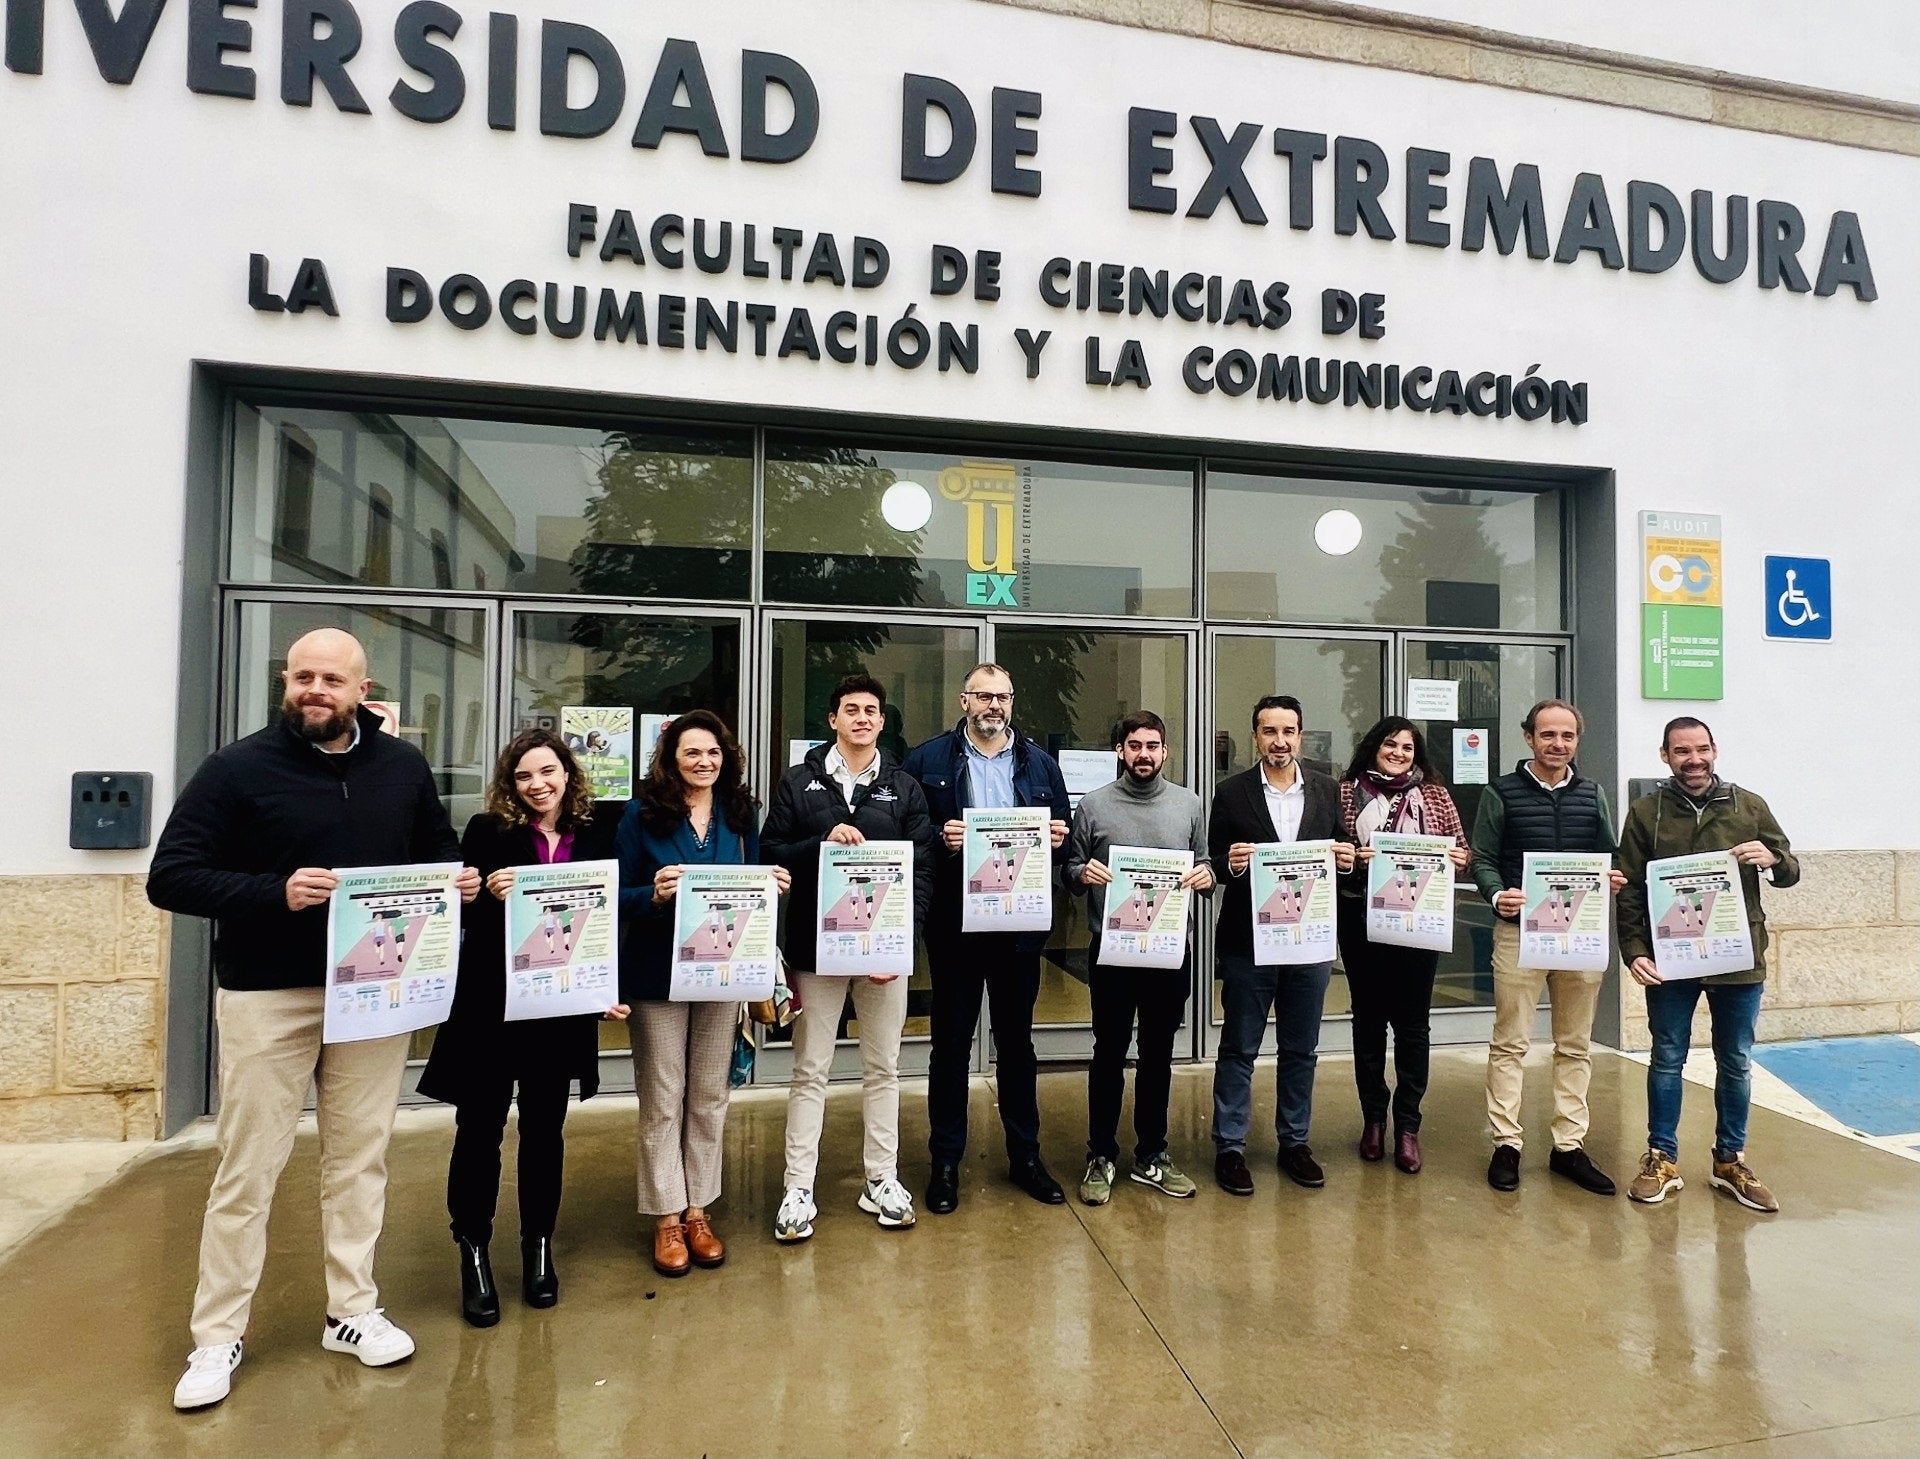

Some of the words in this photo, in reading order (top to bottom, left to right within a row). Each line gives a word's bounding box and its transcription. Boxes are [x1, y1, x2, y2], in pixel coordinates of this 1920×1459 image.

[5, 0, 819, 164] IVERSIDAD
[901, 73, 1041, 198] DE
[1128, 107, 1877, 302] EXTREMADURA
[568, 203, 890, 289] FACULTAD
[930, 245, 1001, 302] DE
[1039, 258, 1291, 330] CIENCIAS
[1322, 289, 1385, 340] DE
[249, 253, 339, 317] LA
[386, 267, 978, 374] DOCUMENTACIÓN
[1014, 329, 1051, 379] Y
[1086, 336, 1151, 389] LA
[1183, 346, 1587, 425] COMUNICACIÓN
[1022, 466, 1032, 528] EXTREMADURA
[1662, 520, 1710, 533] AUDIT
[1022, 533, 1031, 544] DE
[1022, 548, 1031, 608] UNIVERSIDAD
